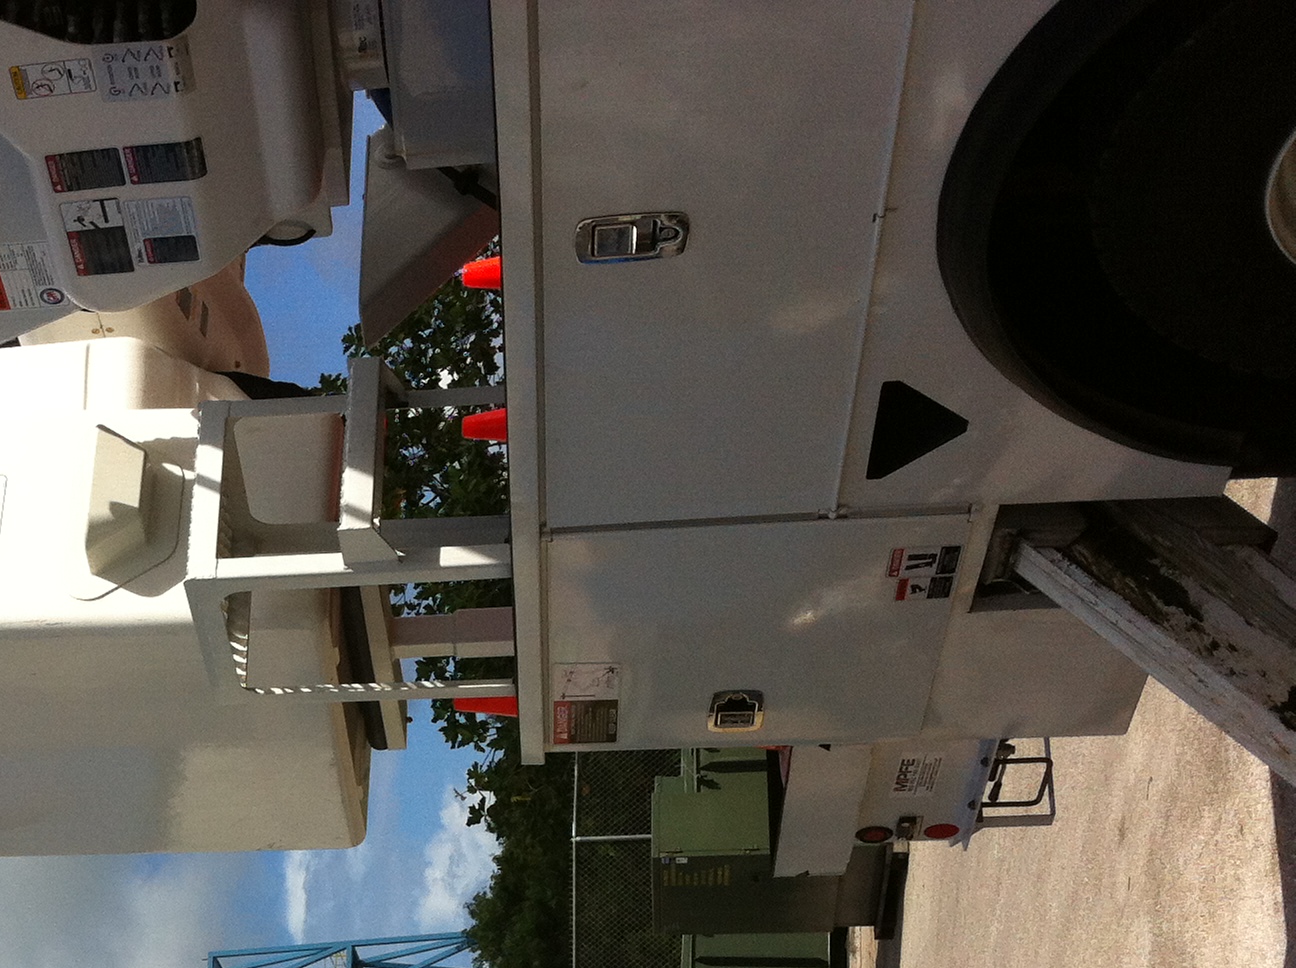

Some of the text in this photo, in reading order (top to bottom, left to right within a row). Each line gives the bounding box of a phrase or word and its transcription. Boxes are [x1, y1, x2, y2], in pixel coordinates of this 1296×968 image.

[49, 160, 61, 181] DANGER
[125, 148, 136, 174] DANGER
[70, 238, 83, 262] DANGER
[556, 706, 568, 732] DANGER
[893, 759, 915, 792] MPFE
